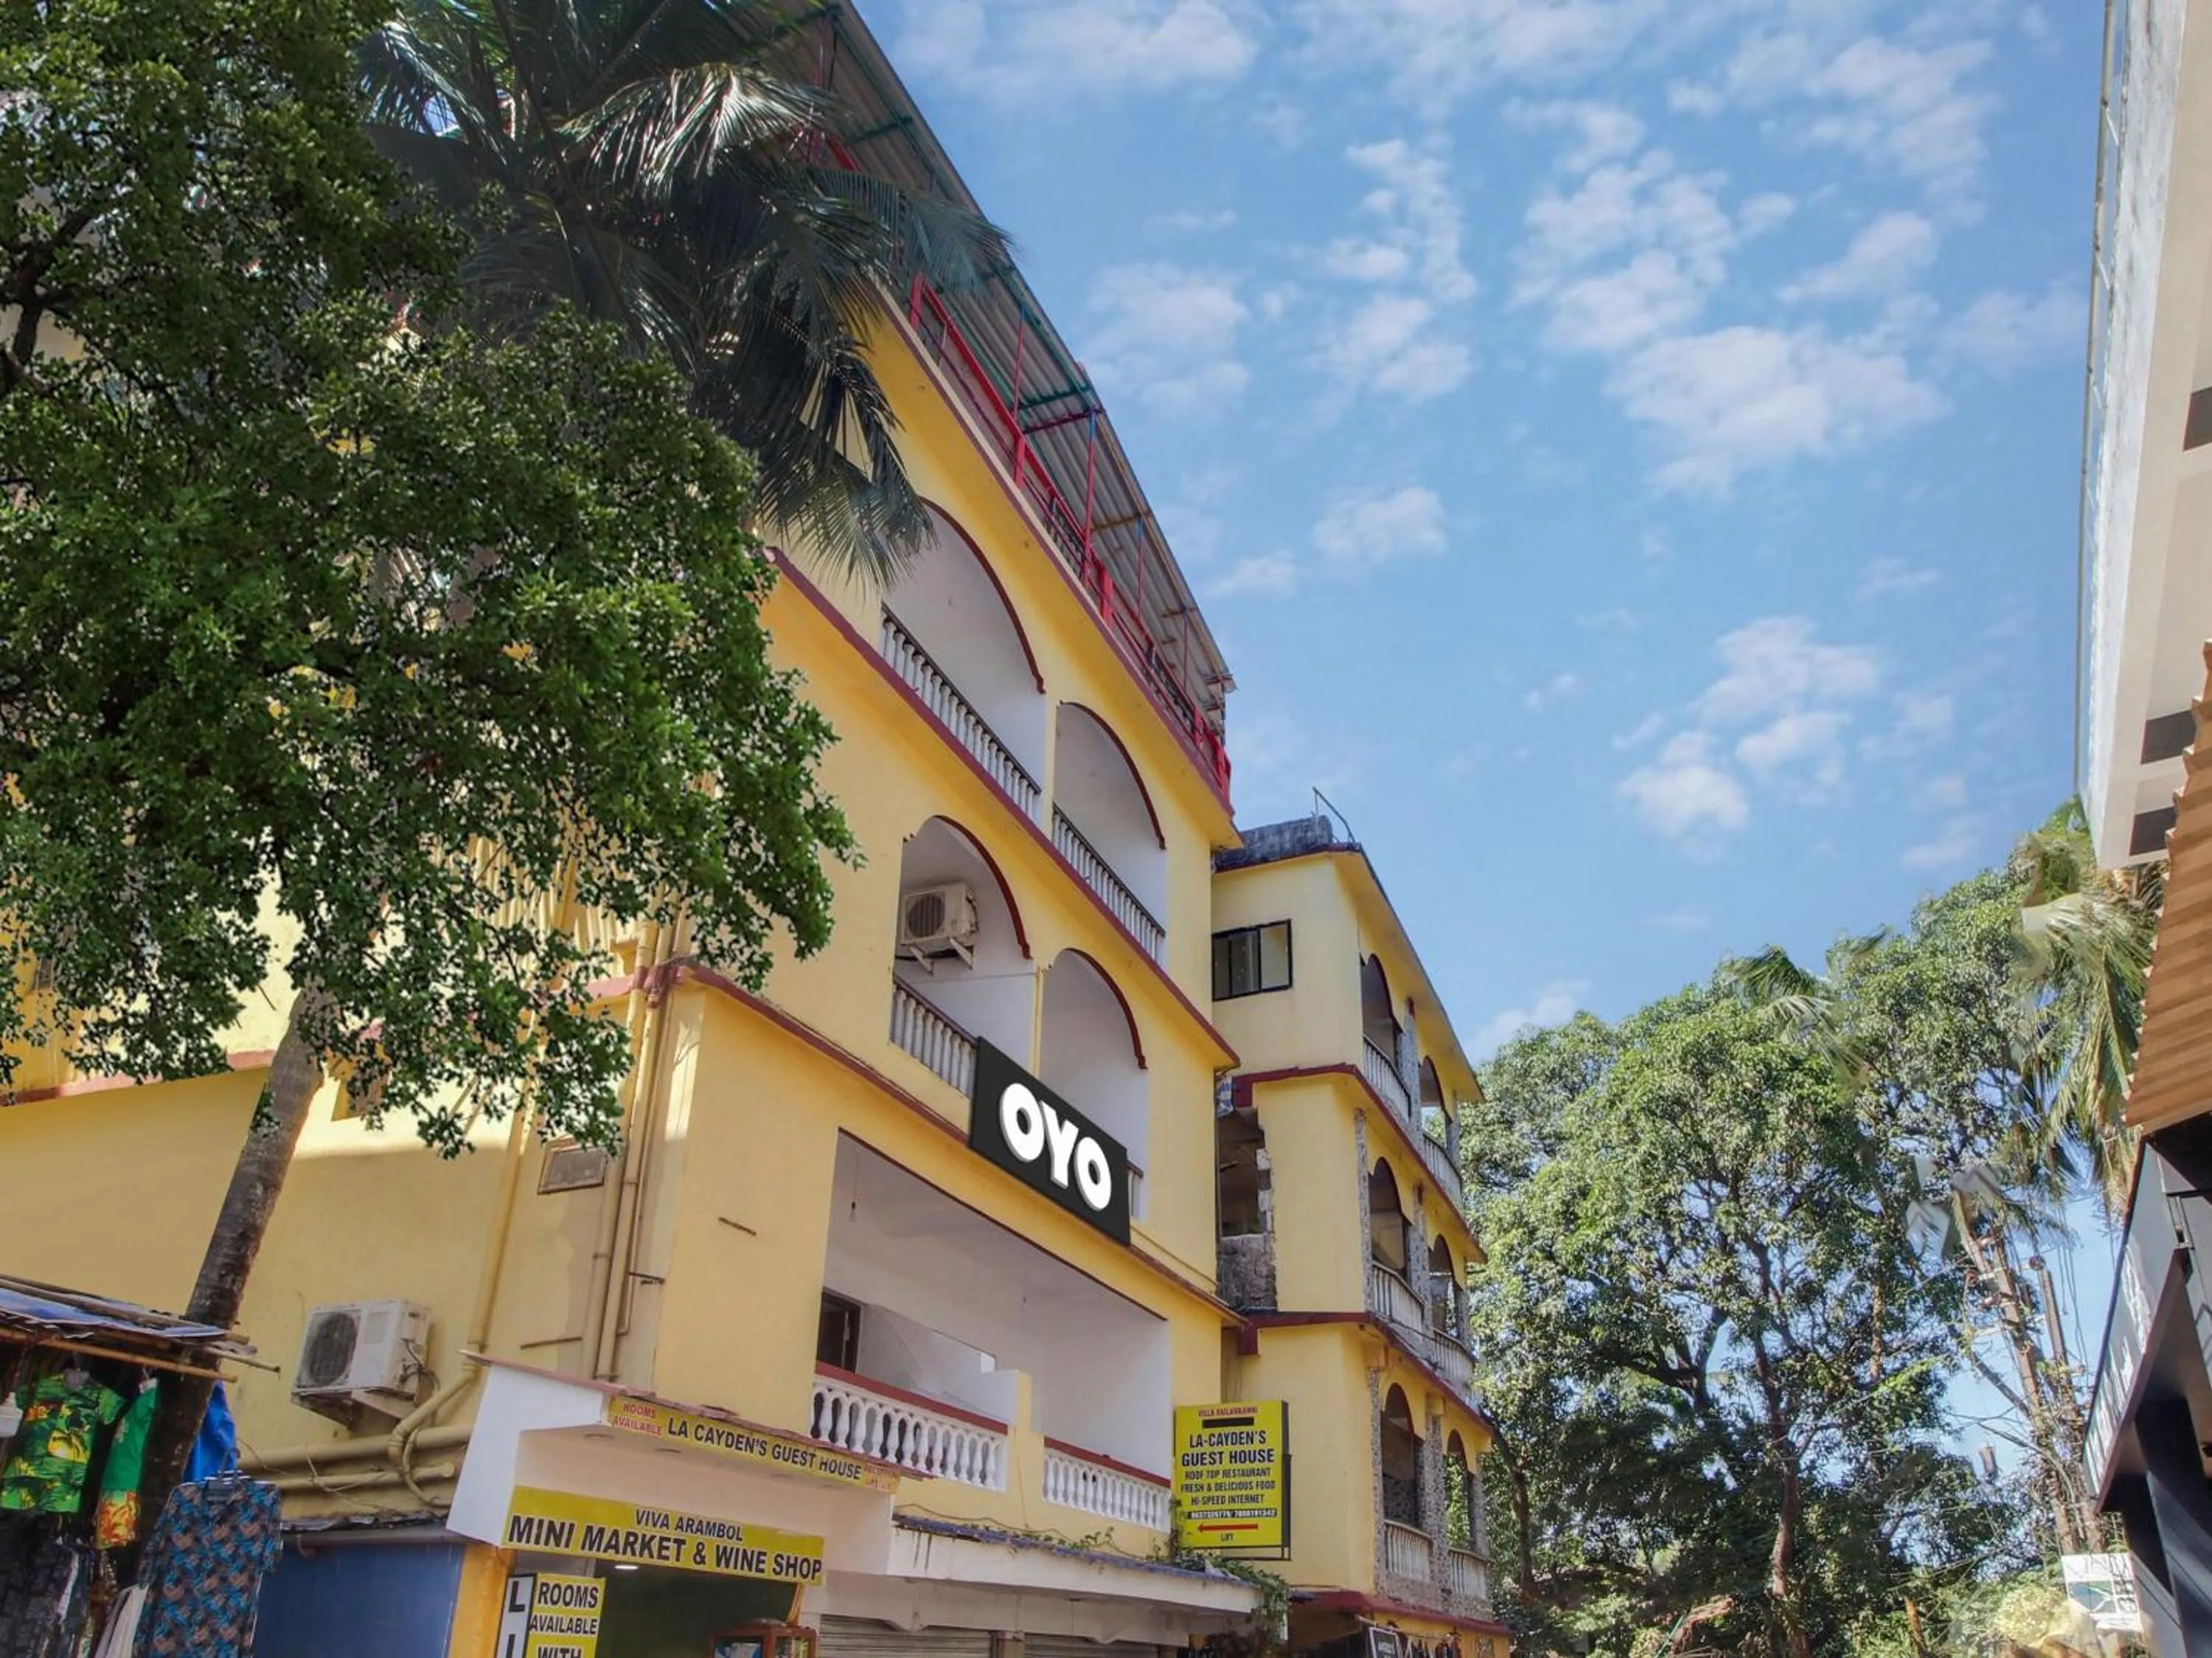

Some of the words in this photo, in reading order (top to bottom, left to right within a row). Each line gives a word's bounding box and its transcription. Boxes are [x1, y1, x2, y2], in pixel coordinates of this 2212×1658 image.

[999, 1082, 1112, 1212] OYO
[622, 1402, 655, 1418] ROOMS
[613, 1415, 662, 1436] AVAILABLE
[667, 1418, 689, 1438] LA
[694, 1424, 768, 1456] CAYDEN'S
[772, 1444, 816, 1468] GUEST
[819, 1457, 862, 1480] HOUSE
[1189, 1430, 1267, 1448] LA-CAYDEN'S
[1181, 1451, 1225, 1467] GUEST
[1229, 1448, 1275, 1464] HOUSE
[1184, 1470, 1204, 1480] ROOF
[1206, 1468, 1220, 1479] TOP
[1222, 1467, 1271, 1478] RESTAURANT
[1180, 1482, 1205, 1494] FRESH
[1206, 1482, 1213, 1491] &
[1214, 1480, 1254, 1492] DELICIOUS
[1256, 1480, 1276, 1491] FOOD
[1228, 1494, 1265, 1504] INTERNET
[636, 1509, 670, 1530] VIVA
[675, 1516, 743, 1542] ARAMBOL
[508, 1515, 576, 1549] MINI
[580, 1525, 686, 1562] MARKET
[692, 1541, 706, 1565] &
[715, 1544, 768, 1573] WINE
[772, 1553, 822, 1581] SHOP
[538, 1581, 599, 1609] ROOMS
[529, 1614, 597, 1635] AVAILABLE
